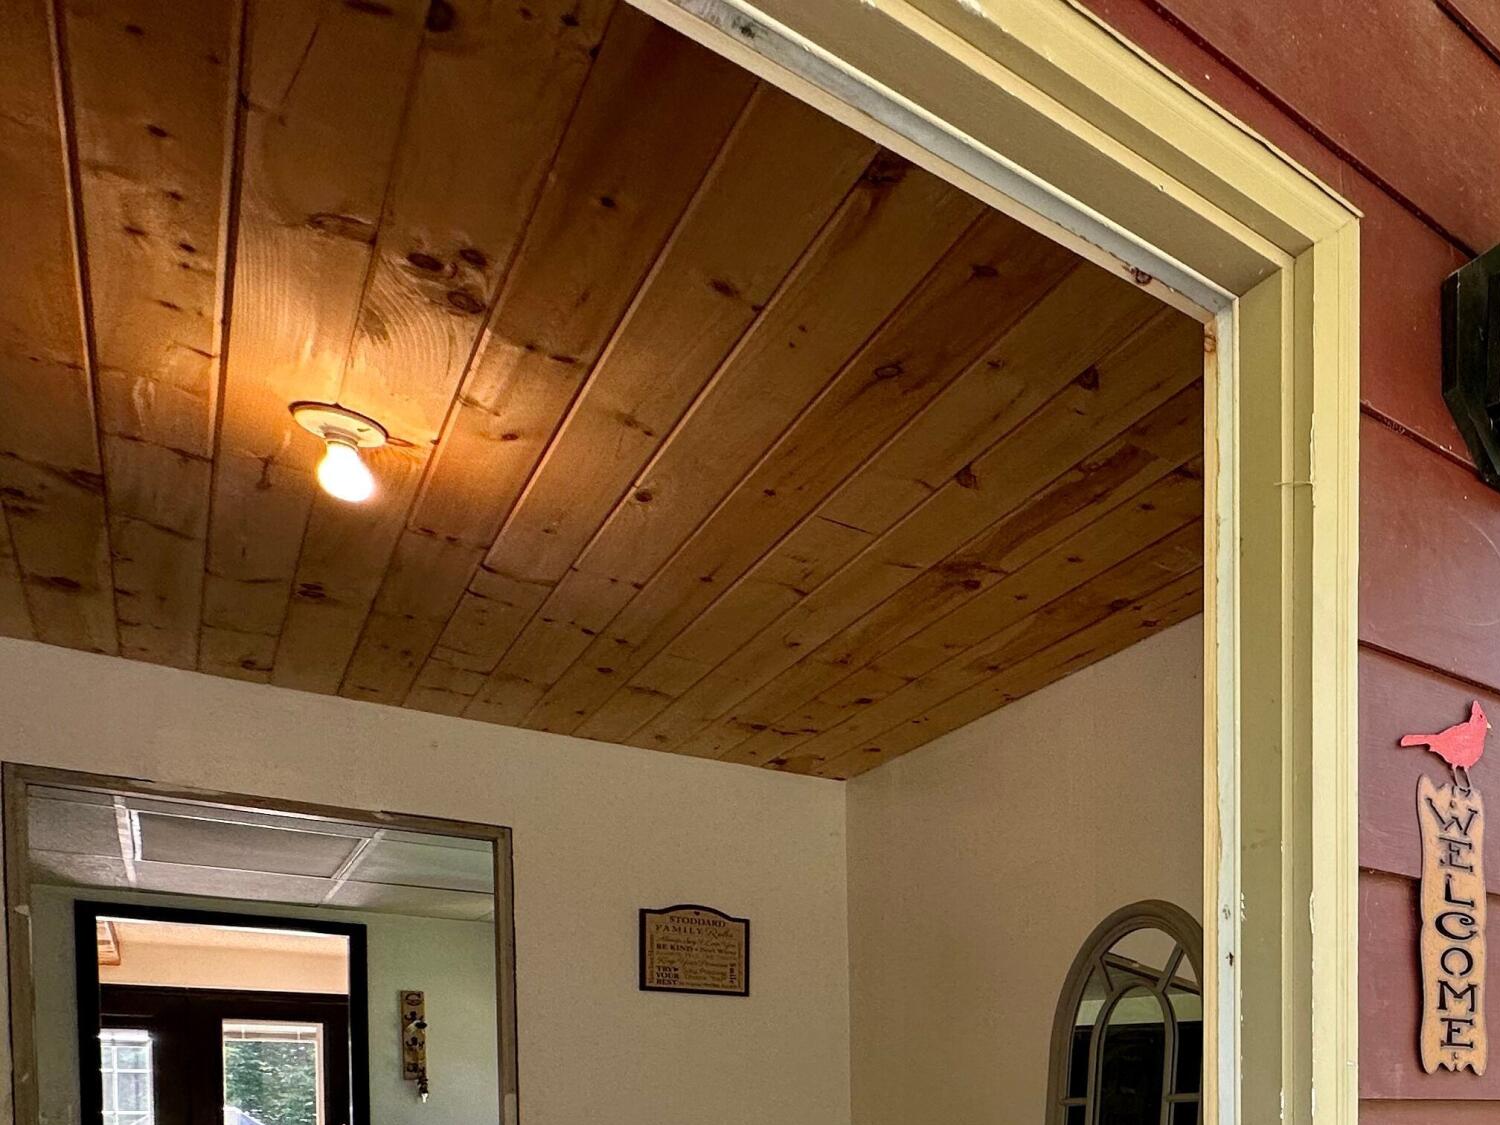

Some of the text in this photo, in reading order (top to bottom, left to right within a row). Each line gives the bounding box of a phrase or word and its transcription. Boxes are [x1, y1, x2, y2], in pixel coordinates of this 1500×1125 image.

[1426, 798, 1478, 1048] WELCOME
[655, 924, 703, 935] FAMILY
[670, 944, 693, 952] KIND
